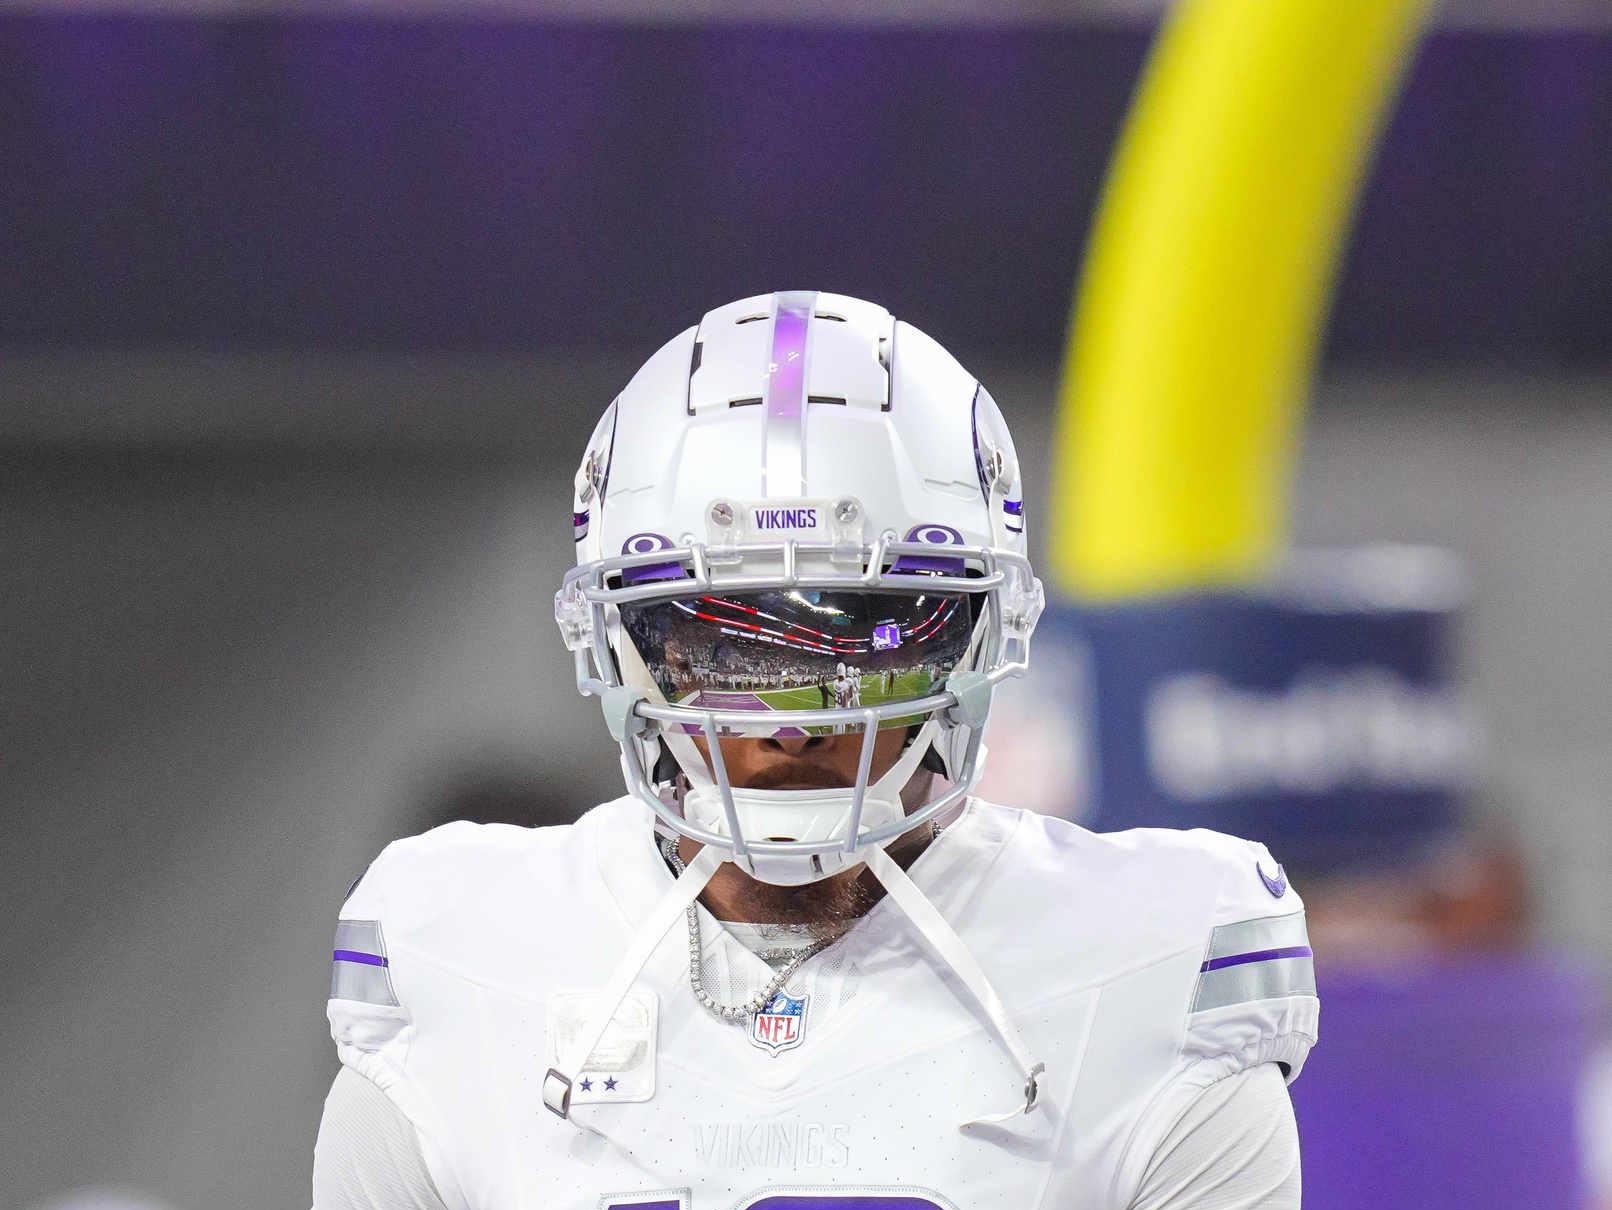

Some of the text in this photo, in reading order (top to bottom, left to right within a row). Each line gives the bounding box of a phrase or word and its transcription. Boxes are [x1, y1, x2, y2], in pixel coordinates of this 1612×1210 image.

[755, 509, 817, 529] VIKINGS
[757, 1016, 796, 1043] NFL
[692, 1122, 851, 1168] VIKINGS
